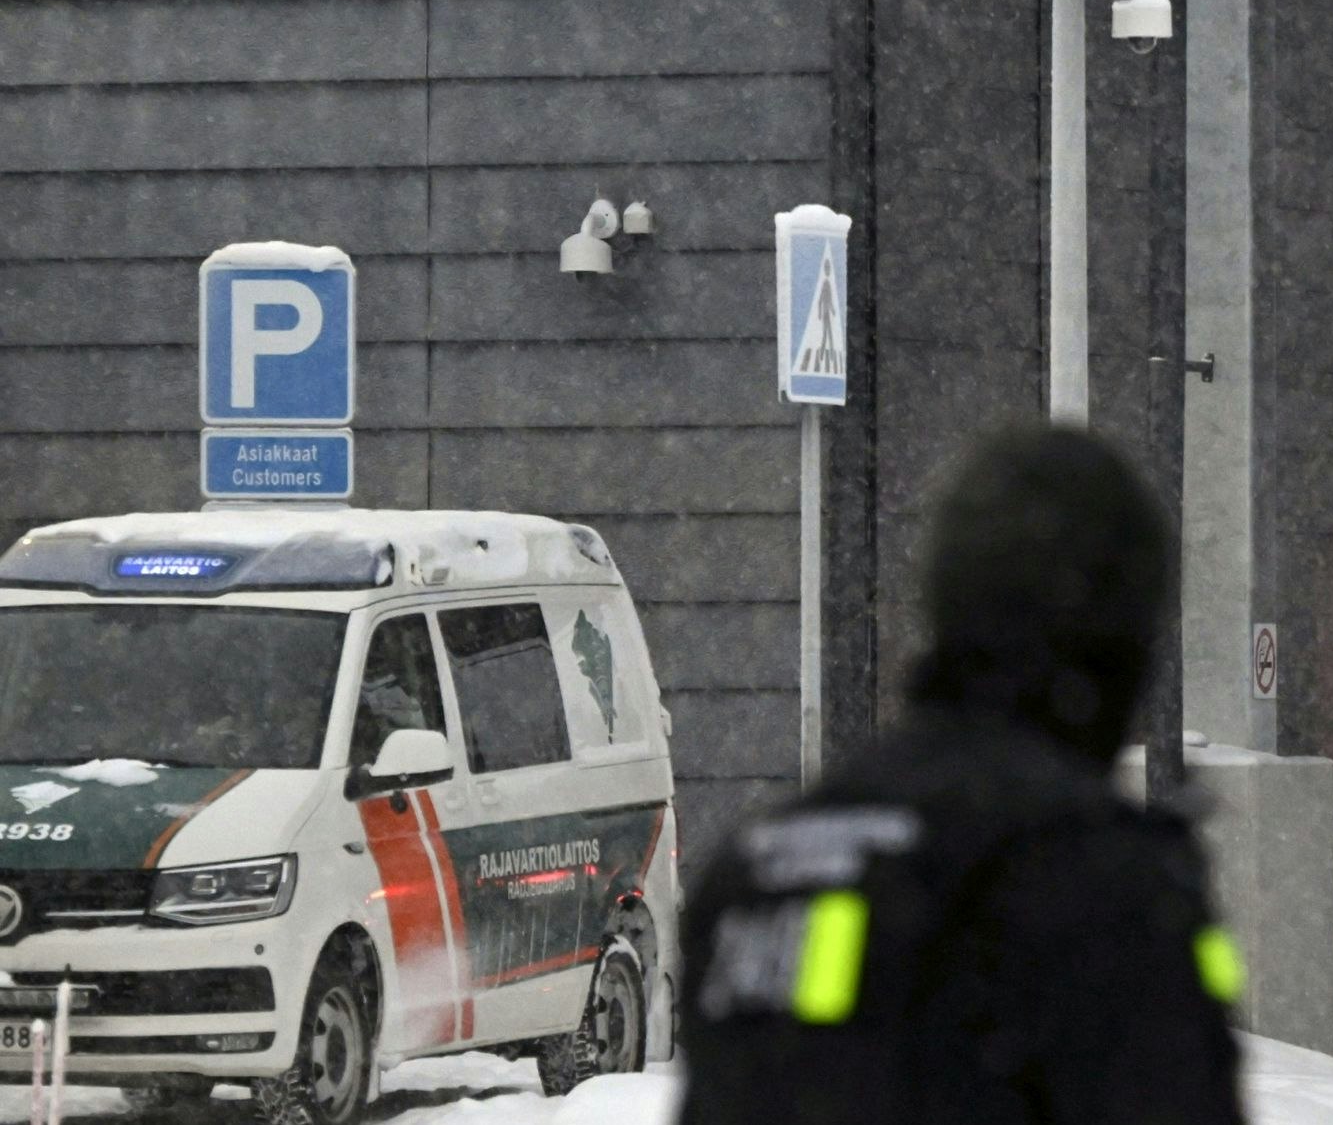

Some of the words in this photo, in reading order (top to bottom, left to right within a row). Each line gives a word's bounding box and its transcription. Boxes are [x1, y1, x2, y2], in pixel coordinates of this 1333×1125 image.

[231, 279, 323, 408] P
[237, 445, 318, 462] Asiakkaat
[232, 469, 322, 486] Customers
[140, 565, 200, 576] LAITOS
[479, 838, 600, 879] RAJAVARTIOLAITOS
